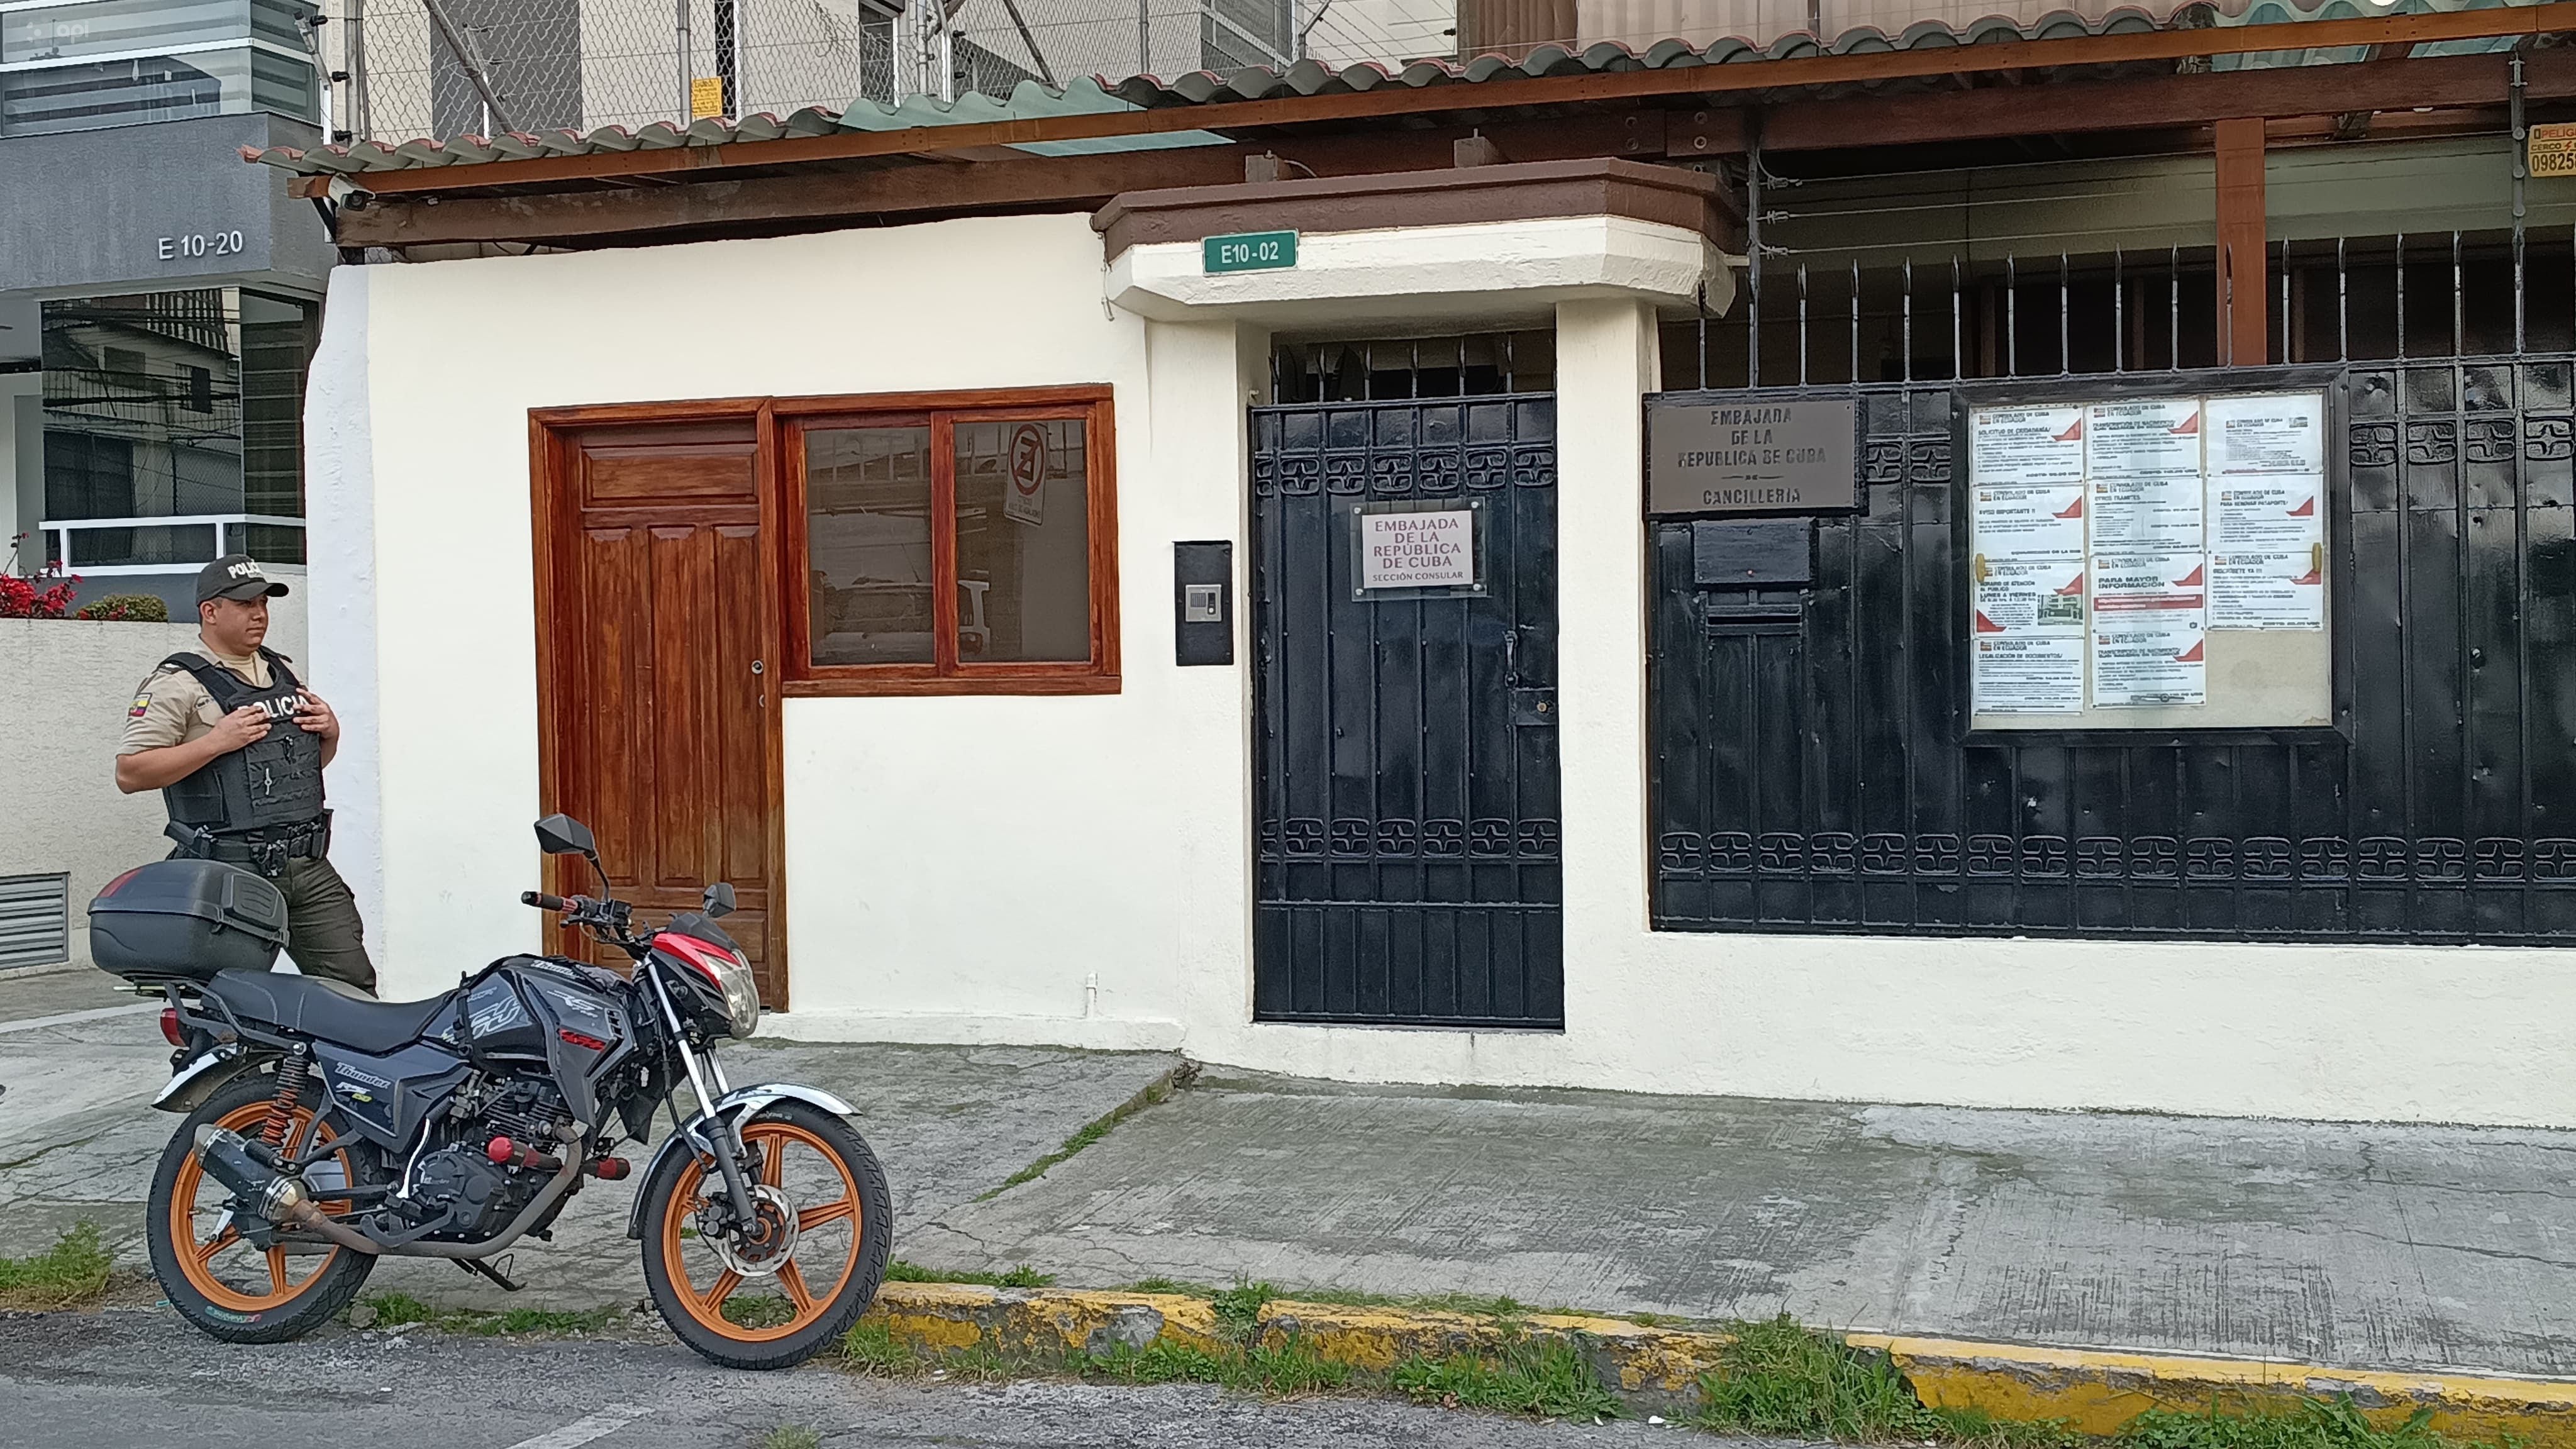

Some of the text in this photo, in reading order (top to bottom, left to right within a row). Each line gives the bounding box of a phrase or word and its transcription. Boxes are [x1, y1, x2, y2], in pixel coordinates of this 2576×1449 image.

[2541, 128, 2576, 138] PELIG
[2531, 142, 2562, 150] CERCO
[2532, 152, 2576, 172] 09825
[158, 230, 243, 259] E 10-20
[1221, 242, 1279, 264] E10-02
[1755, 430, 1772, 445] LA
[1786, 448, 1826, 464] CUBA
[1375, 518, 1458, 531] EMBAJADA
[1395, 531, 1439, 543] DE LA
[1374, 543, 1461, 557] REPÚBLICA
[1384, 556, 1452, 569] DE CUBA
[1373, 571, 1463, 582] SECCIÓN CONSULAR
[238, 695, 309, 718] OLICIA
[334, 1062, 391, 1089] Thunder
